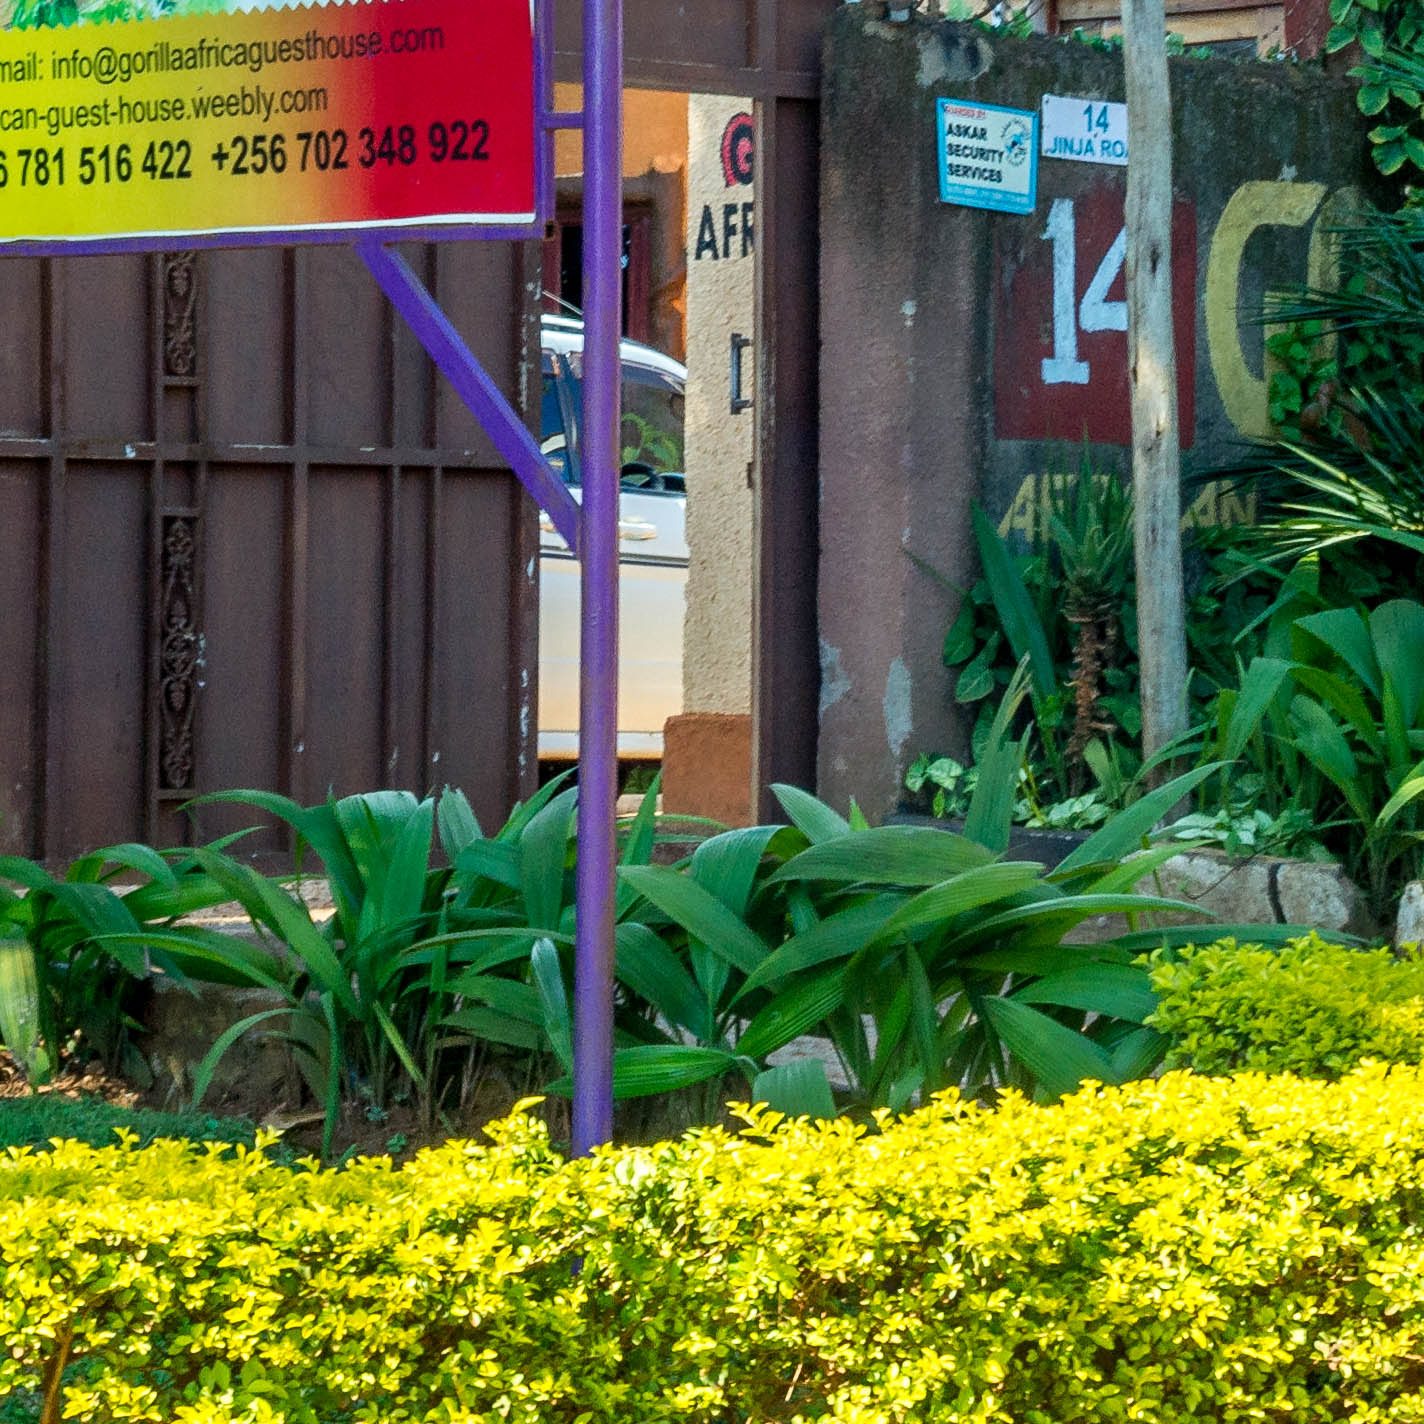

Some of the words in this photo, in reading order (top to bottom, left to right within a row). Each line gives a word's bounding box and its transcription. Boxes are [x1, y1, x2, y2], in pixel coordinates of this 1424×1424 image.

[51, 25, 446, 85] info@gorillaafricaguesthouse.com
[1082, 103, 1109, 133] 14
[946, 122, 988, 141] ASKAR
[16, 146, 65, 187] 781
[78, 143, 133, 186] 516
[141, 139, 193, 181] 422
[211, 132, 287, 176] +256
[295, 128, 349, 172] 702
[358, 124, 418, 169] 348
[428, 119, 491, 162] 922
[946, 143, 1005, 164] SECURITY
[1048, 136, 1095, 158] JINJA
[1101, 139, 1129, 160] RO
[946, 162, 1003, 184] SERVICES
